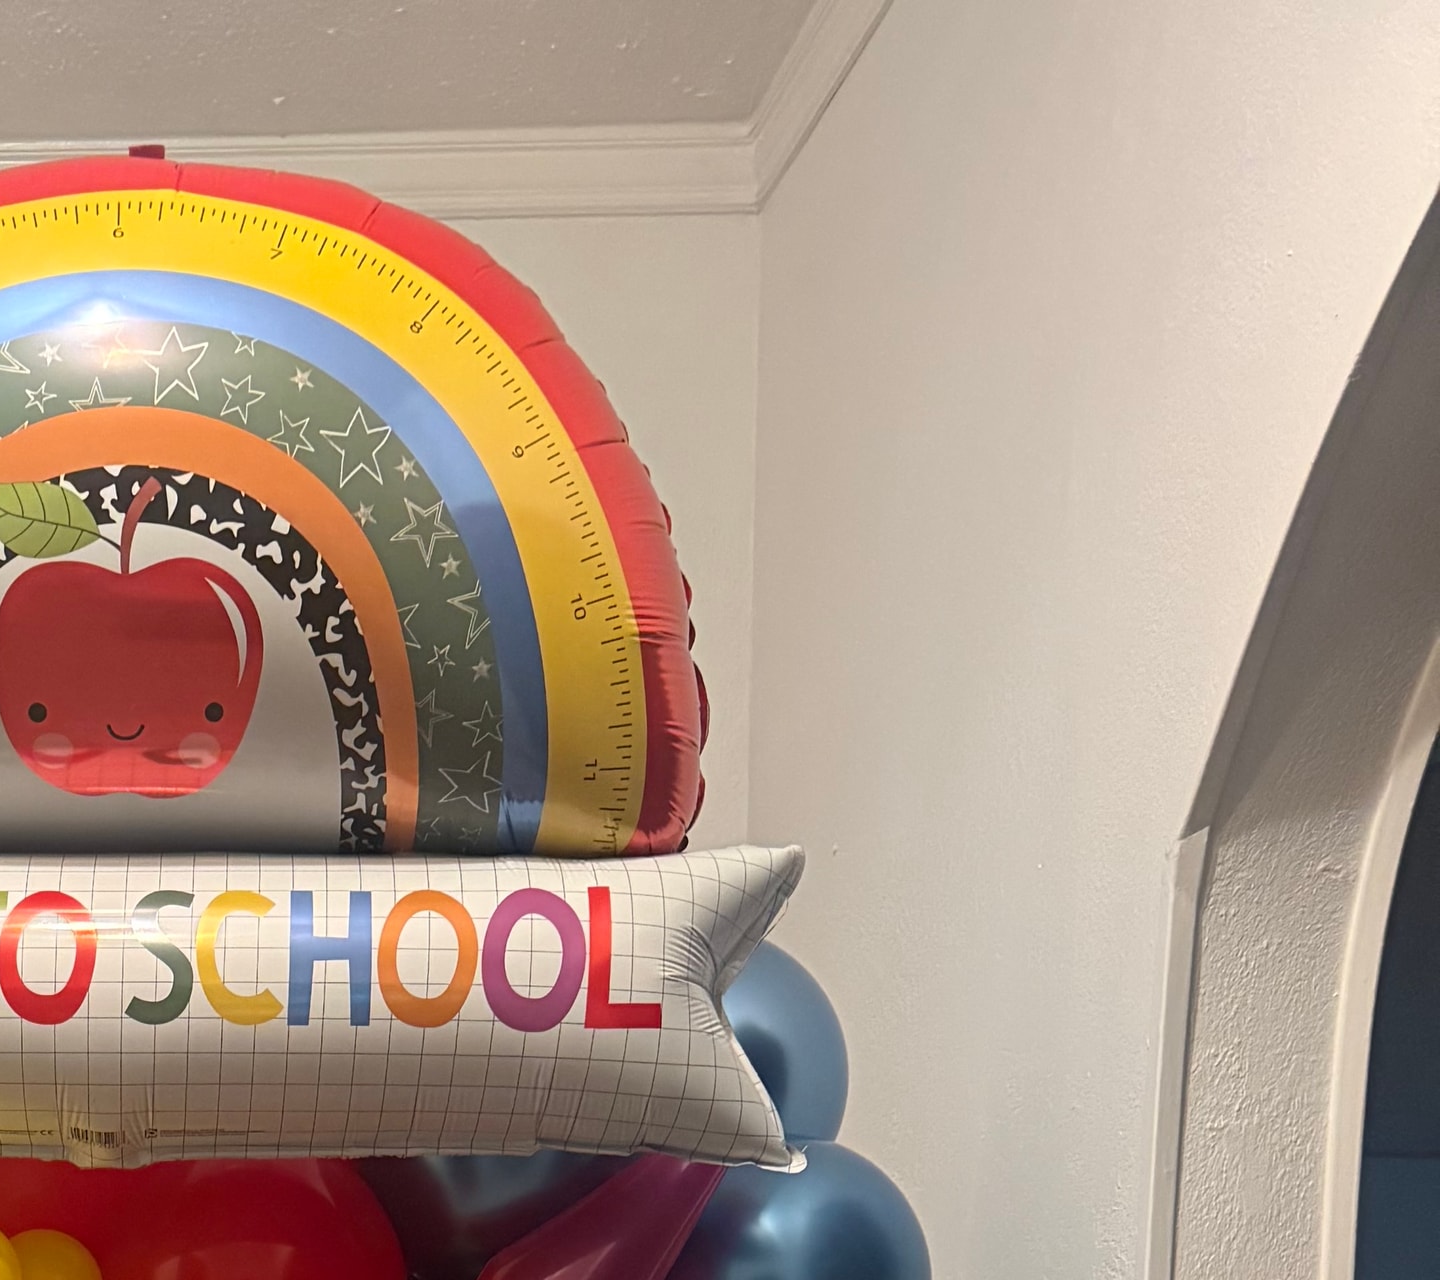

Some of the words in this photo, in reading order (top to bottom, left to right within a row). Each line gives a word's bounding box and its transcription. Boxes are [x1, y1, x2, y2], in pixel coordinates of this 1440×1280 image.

[112, 227, 124, 238] 6
[270, 248, 283, 260] 7
[410, 320, 423, 334] 8
[511, 445, 524, 459] 9
[570, 592, 587, 621] 10
[583, 758, 597, 780] 11
[124, 886, 662, 1032] SCHOOL
